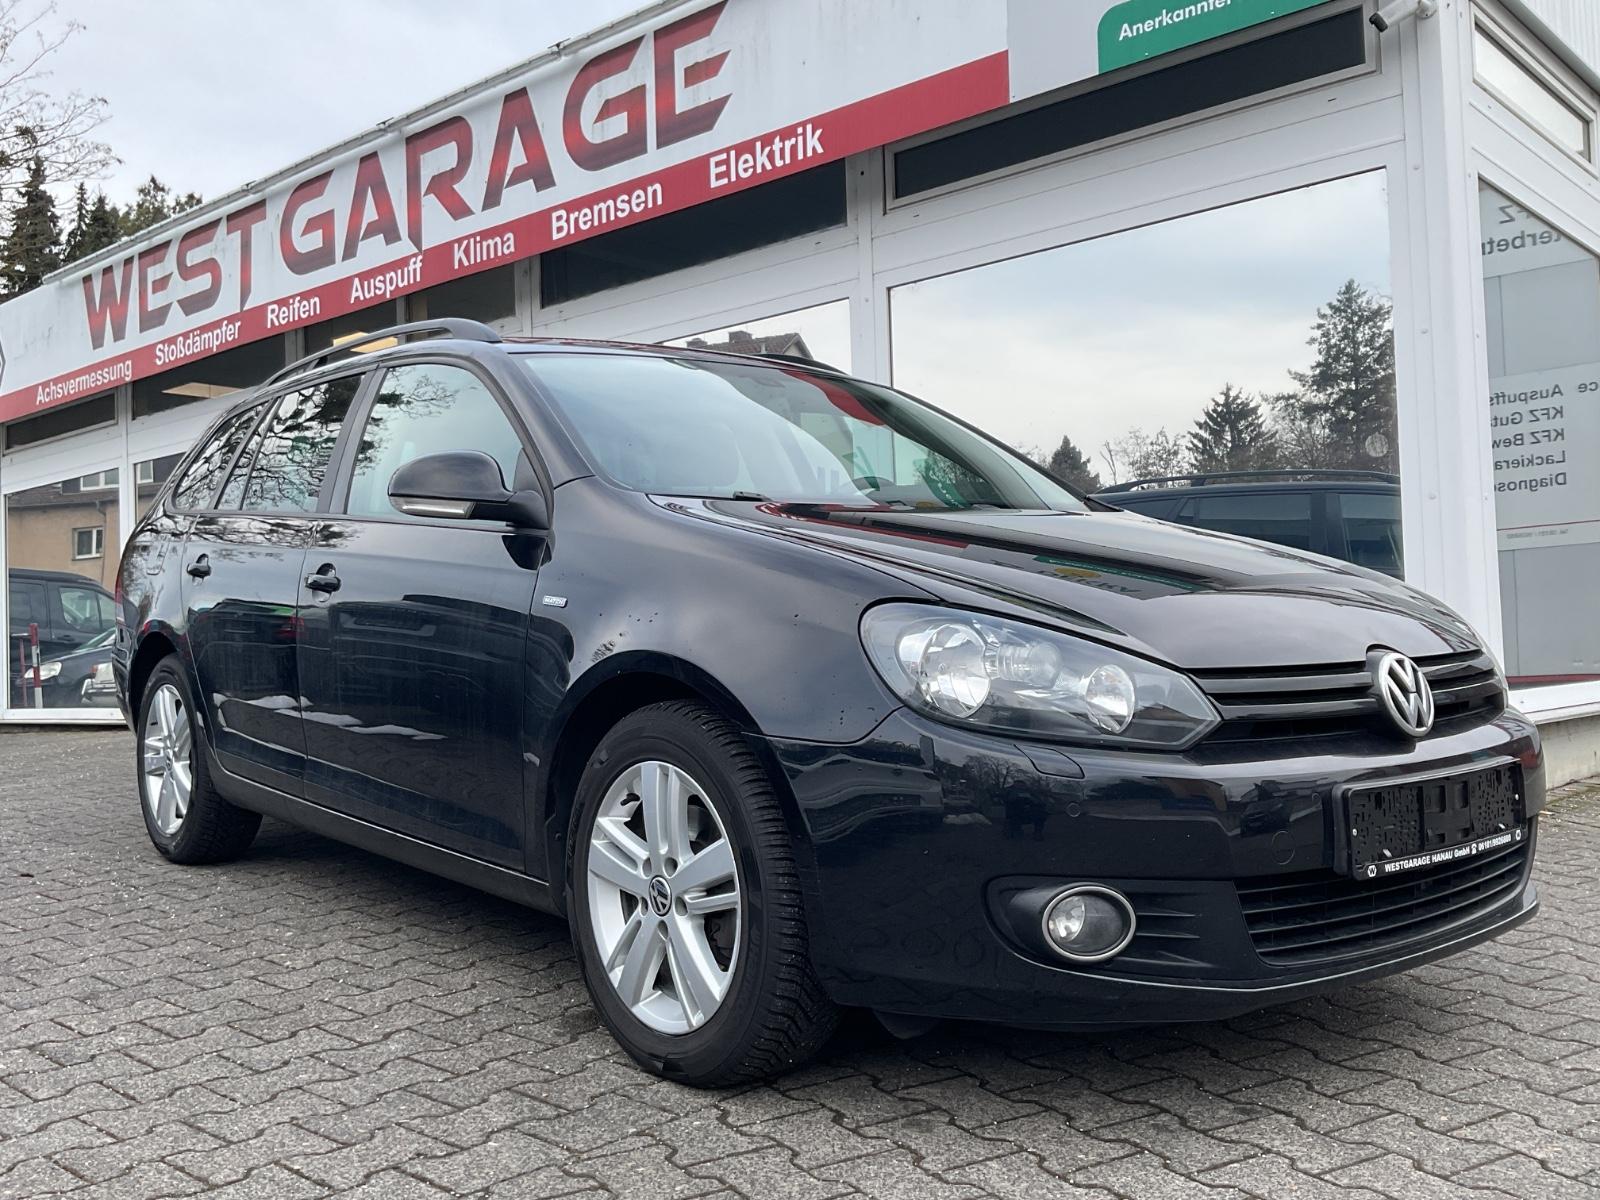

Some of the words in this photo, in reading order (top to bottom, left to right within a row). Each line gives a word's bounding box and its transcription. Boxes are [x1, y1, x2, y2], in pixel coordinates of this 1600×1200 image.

[36, 360, 133, 405] Achsvermessung
[155, 320, 242, 366] Stoßdämpfer
[267, 296, 321, 329] Reifen
[350, 255, 423, 304] Auspuff
[453, 231, 515, 270] Klima
[551, 182, 663, 241] Bremsen
[709, 124, 824, 189] Elektrik
[1384, 855, 1431, 873] WESTGARAGE
[1431, 848, 1453, 864] HANAU
[1454, 846, 1470, 858] GmbH
